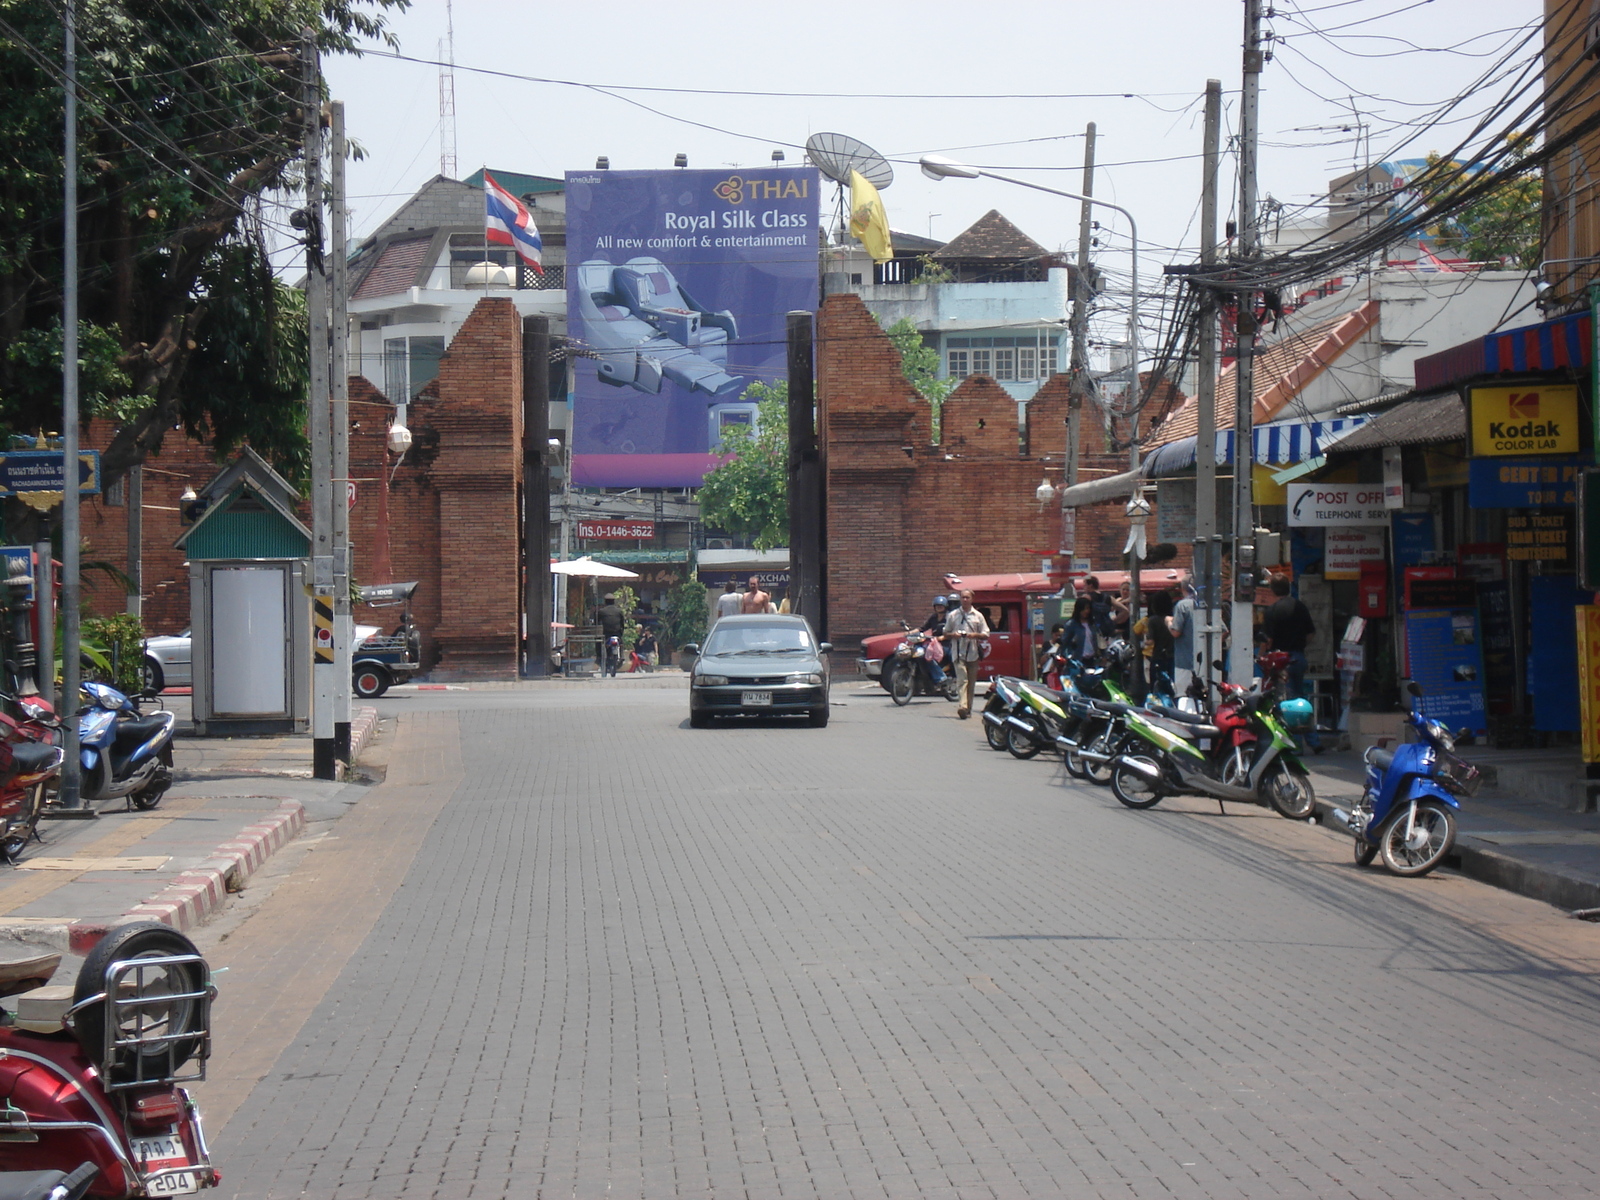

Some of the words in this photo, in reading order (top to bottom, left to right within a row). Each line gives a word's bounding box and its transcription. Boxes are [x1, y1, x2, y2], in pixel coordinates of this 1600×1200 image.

[745, 179, 808, 199] THAI
[665, 210, 716, 233] Royal
[722, 209, 756, 229] Silk
[762, 209, 808, 228] Class
[595, 235, 613, 249] All
[616, 238, 643, 249] new
[647, 234, 697, 248] comfort
[700, 235, 712, 248] &
[715, 233, 807, 248] entertainment
[1489, 421, 1560, 439] Kodak
[1495, 440, 1534, 451] COLOR
[1537, 439, 1557, 449] LAB
[1500, 466, 1558, 483] CENTER
[1316, 492, 1348, 504] POST
[1356, 491, 1384, 504] OFFI
[1527, 491, 1557, 504] TOUR
[1315, 510, 1362, 519] TELEPHONE
[1368, 509, 1389, 519] SERV
[1508, 516, 1527, 528] BUS
[1531, 515, 1565, 527] TICKET
[1534, 530, 1568, 543] TICKET
[155, 1173, 189, 1192] 204
